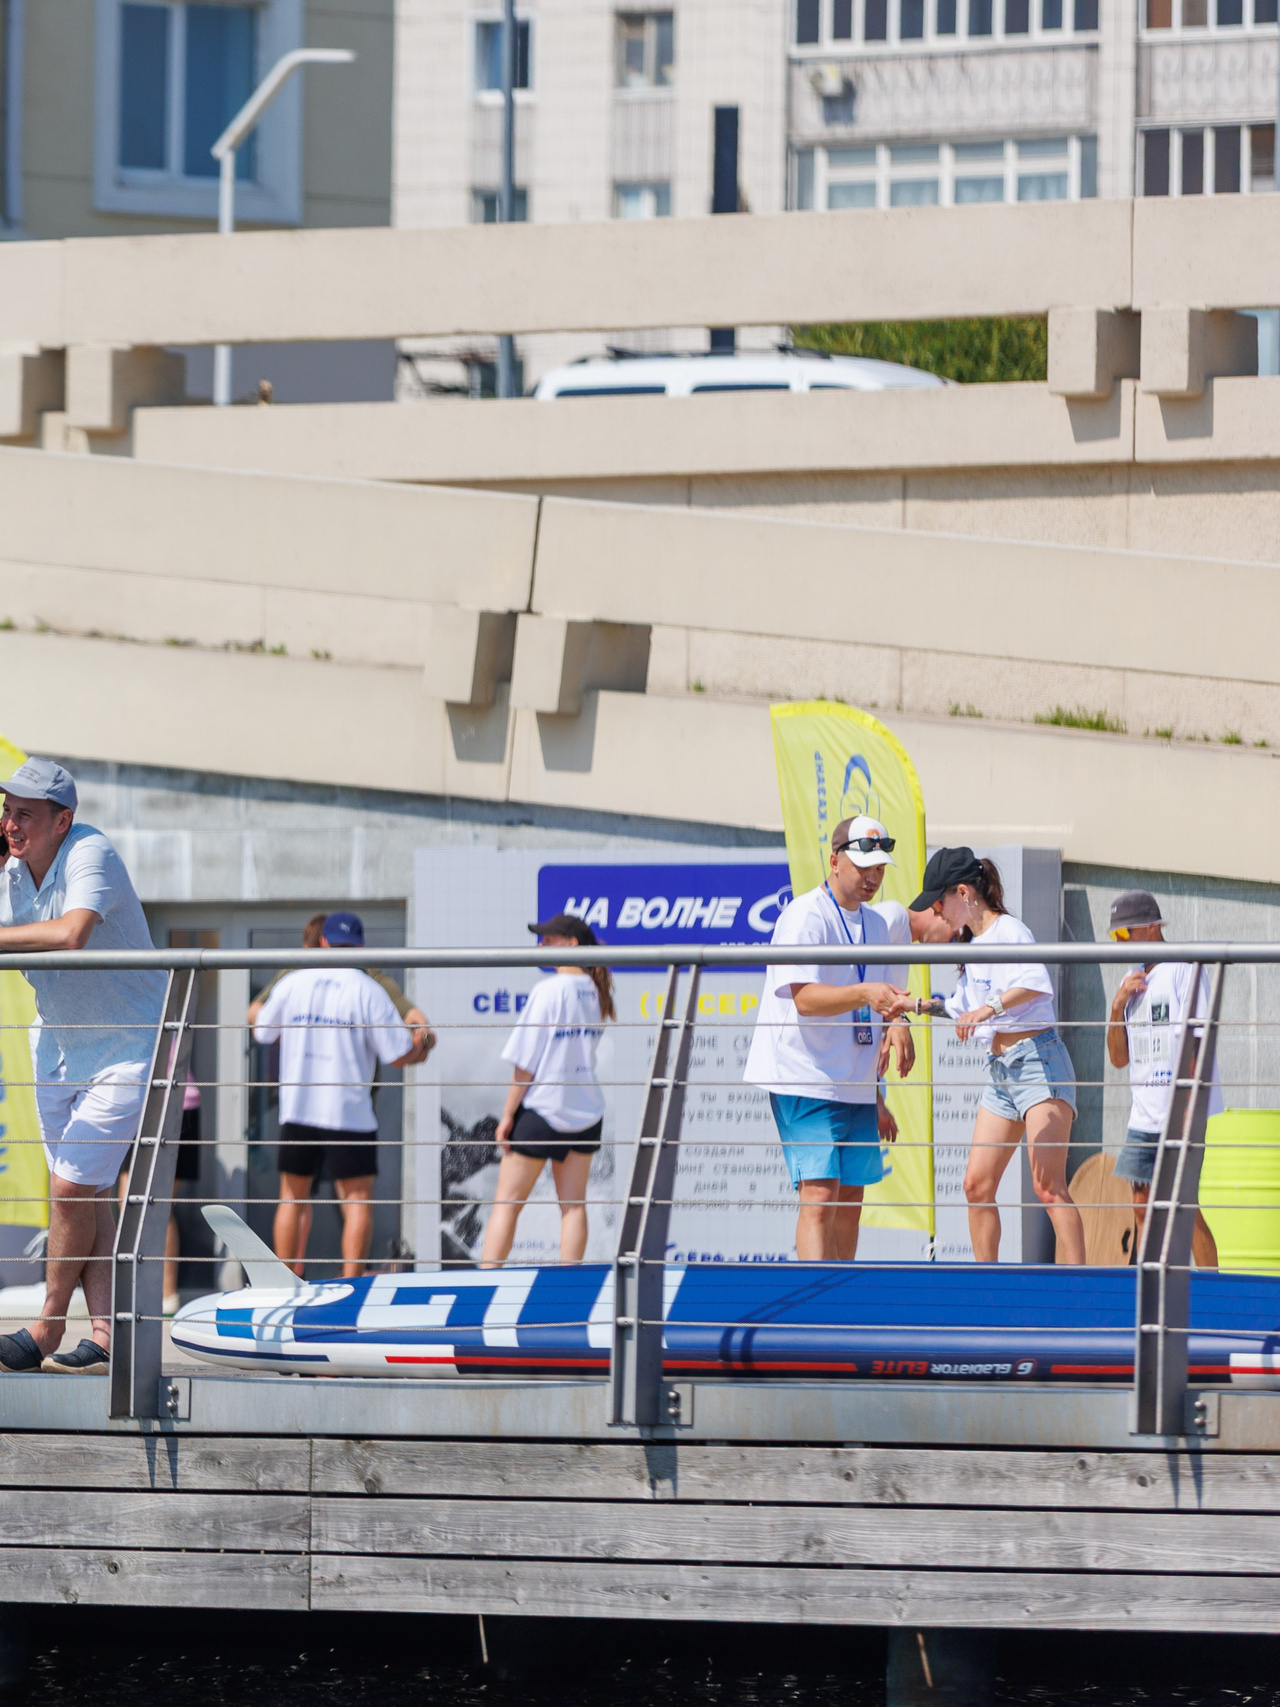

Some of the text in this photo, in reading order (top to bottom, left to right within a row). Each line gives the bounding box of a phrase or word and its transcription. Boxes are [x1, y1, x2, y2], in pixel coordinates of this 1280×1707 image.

[561, 896, 743, 929] НА ВОЛНЕ
[473, 986, 529, 1013] СЁР
[698, 993, 758, 1014] СЕР
[857, 1032, 872, 1044] ORG
[727, 1092, 769, 1103] входи
[713, 1162, 788, 1175] становитс
[870, 1360, 929, 1375] ELITE
